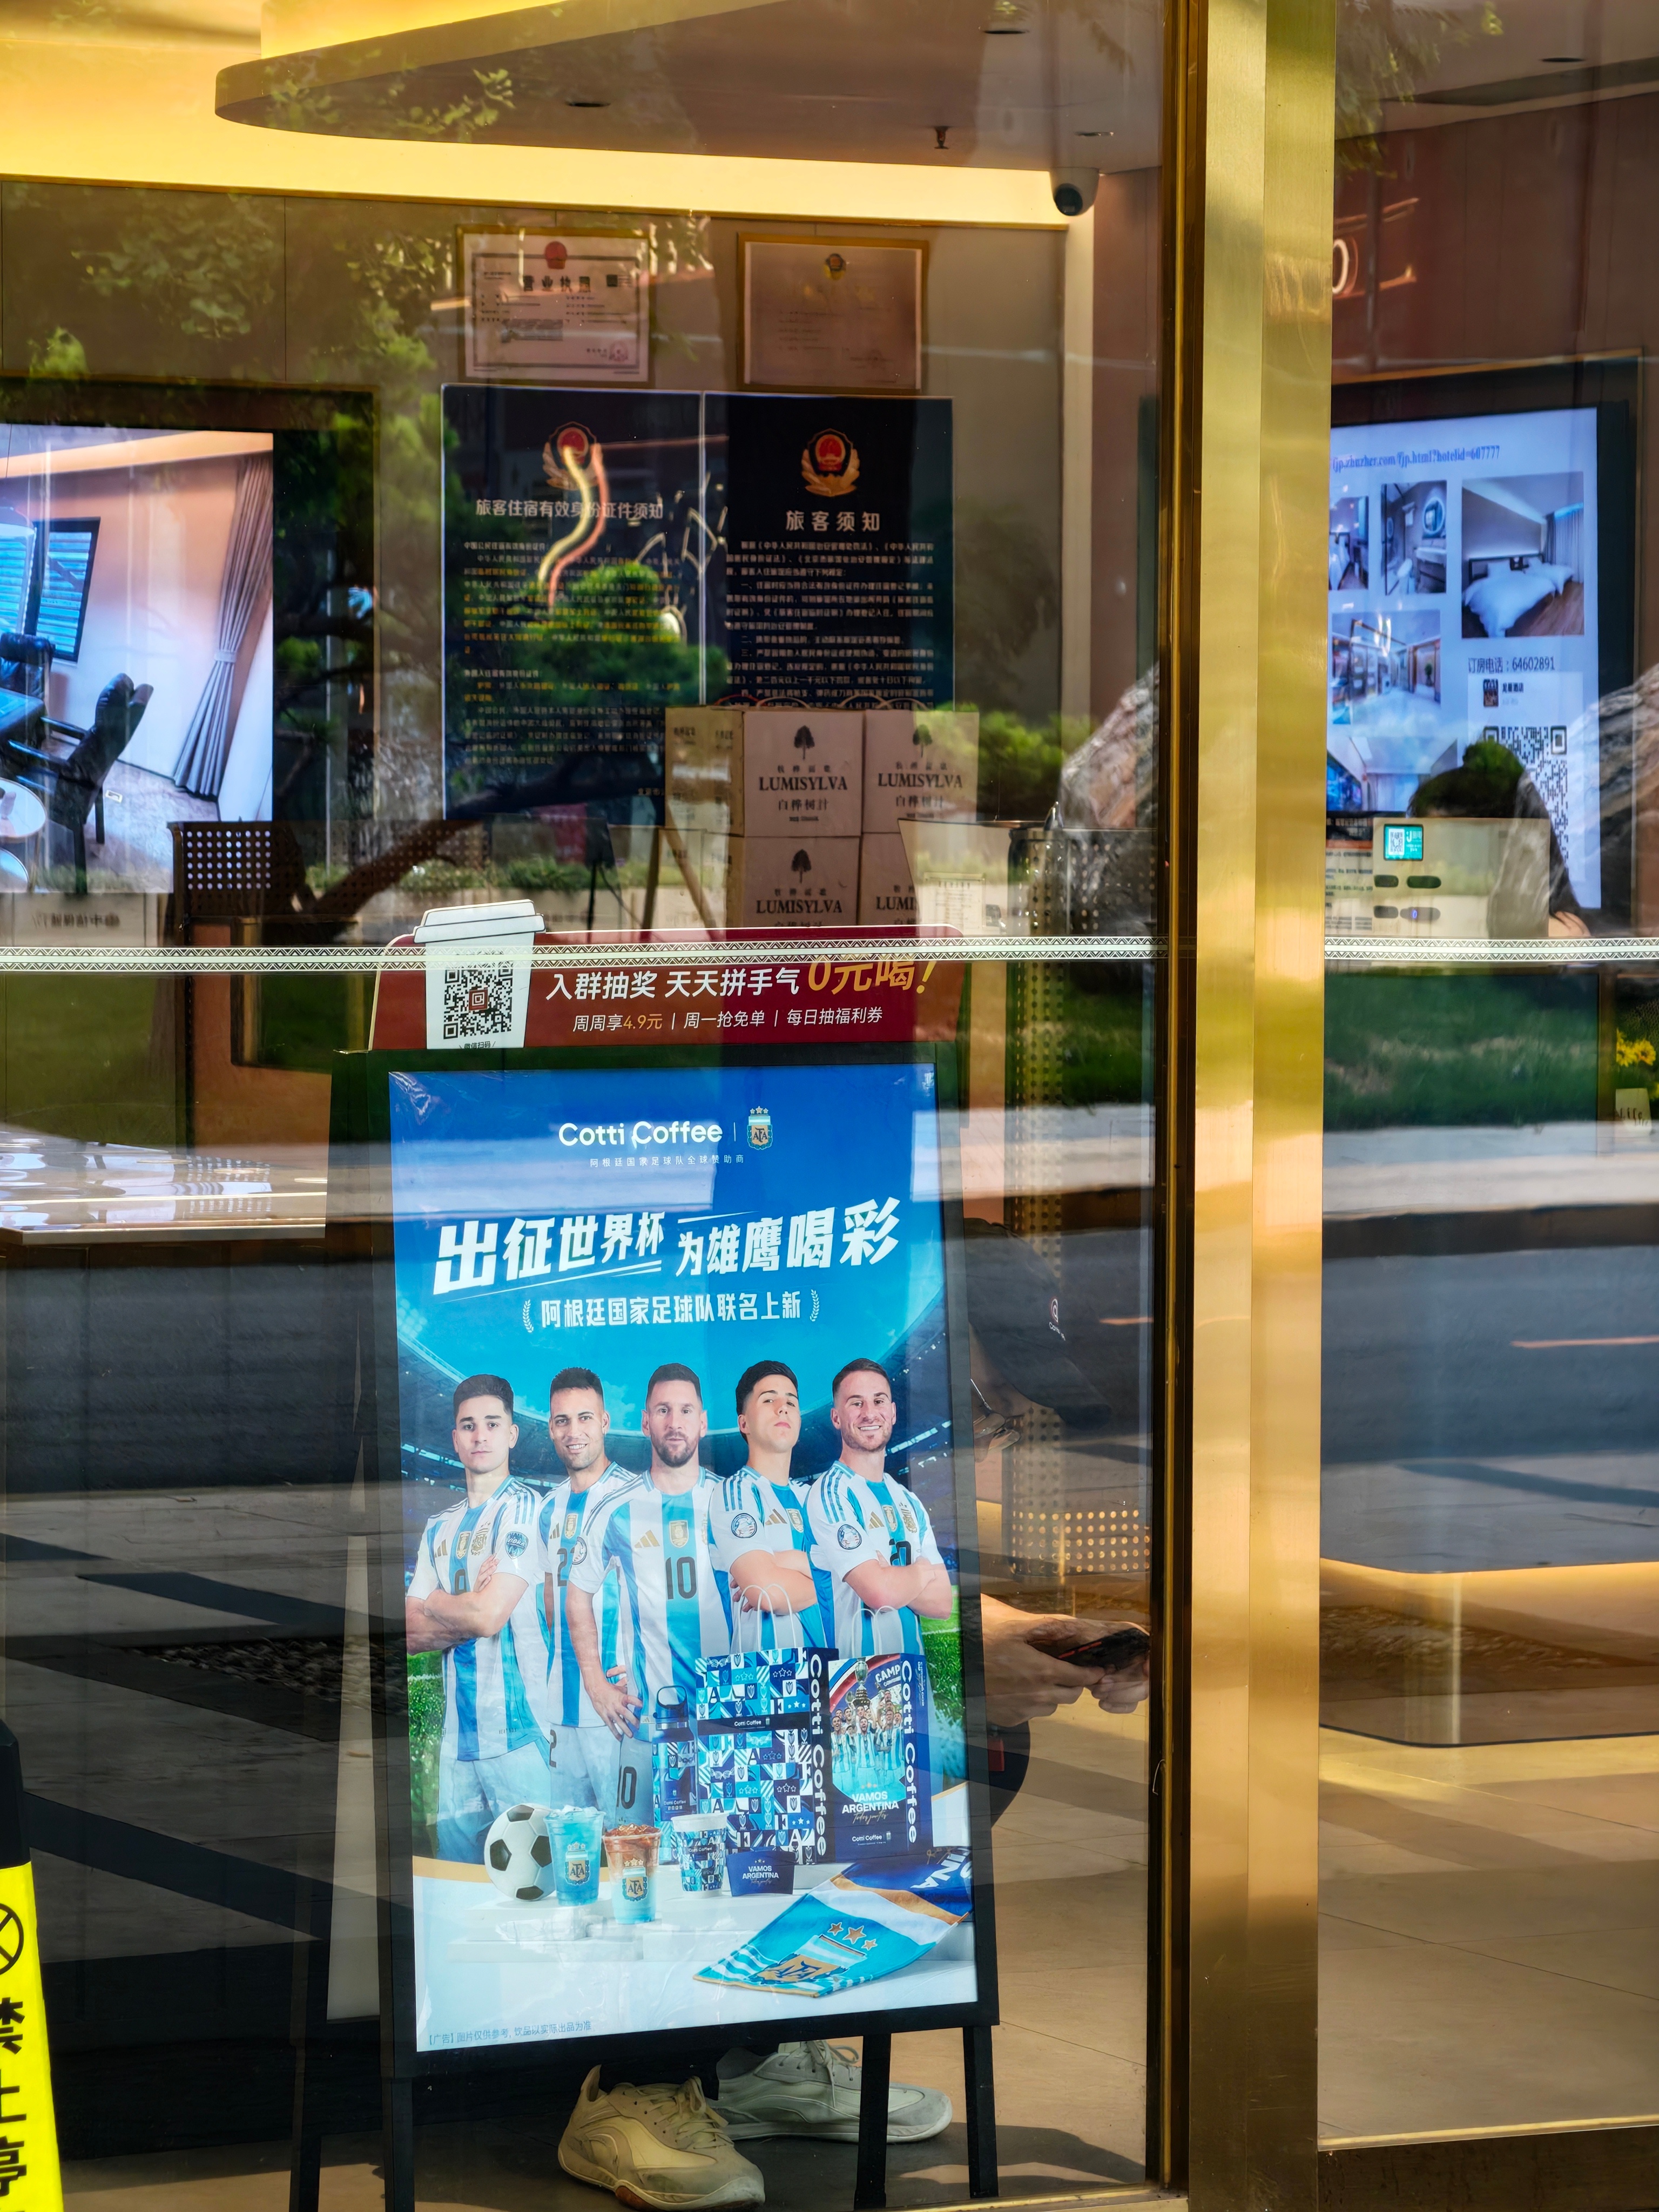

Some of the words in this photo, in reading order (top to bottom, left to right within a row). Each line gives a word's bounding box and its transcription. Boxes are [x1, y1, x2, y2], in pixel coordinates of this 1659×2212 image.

[476, 499, 663, 519] 旅客住宿有效身份证件须知
[786, 510, 880, 532] 旅客须知
[759, 777, 847, 791] LUMISYLVA
[878, 773, 963, 788] LUMISYLVA
[757, 899, 842, 914] LUMISYLVA
[545, 970, 658, 1001] 入群抽奖
[665, 967, 800, 997] 天天拼手气
[573, 1013, 663, 1032] 周周享4.9元
[684, 1010, 765, 1029] 周一抢免单
[786, 1006, 882, 1026] 每日抽福利券
[558, 1122, 625, 1147] Cotti
[633, 1121, 723, 1144] Coffee
[590, 1154, 744, 1168] 阿根廷国家足球队全球赞助商
[433, 1211, 665, 1295] 出征世界杯
[675, 1196, 901, 1277] 为雄鹰喝彩
[541, 1291, 801, 1328] 阿根廷国家足球队联名上新
[665, 1556, 697, 1600] 10
[811, 1654, 823, 1735] Cotti
[902, 1660, 914, 1735] Cotti
[813, 1744, 827, 1856] Coffee
[852, 1791, 888, 1803] VAMOS
[905, 1742, 918, 1843] Coffee
[841, 1800, 900, 1814] ARGENTINA
